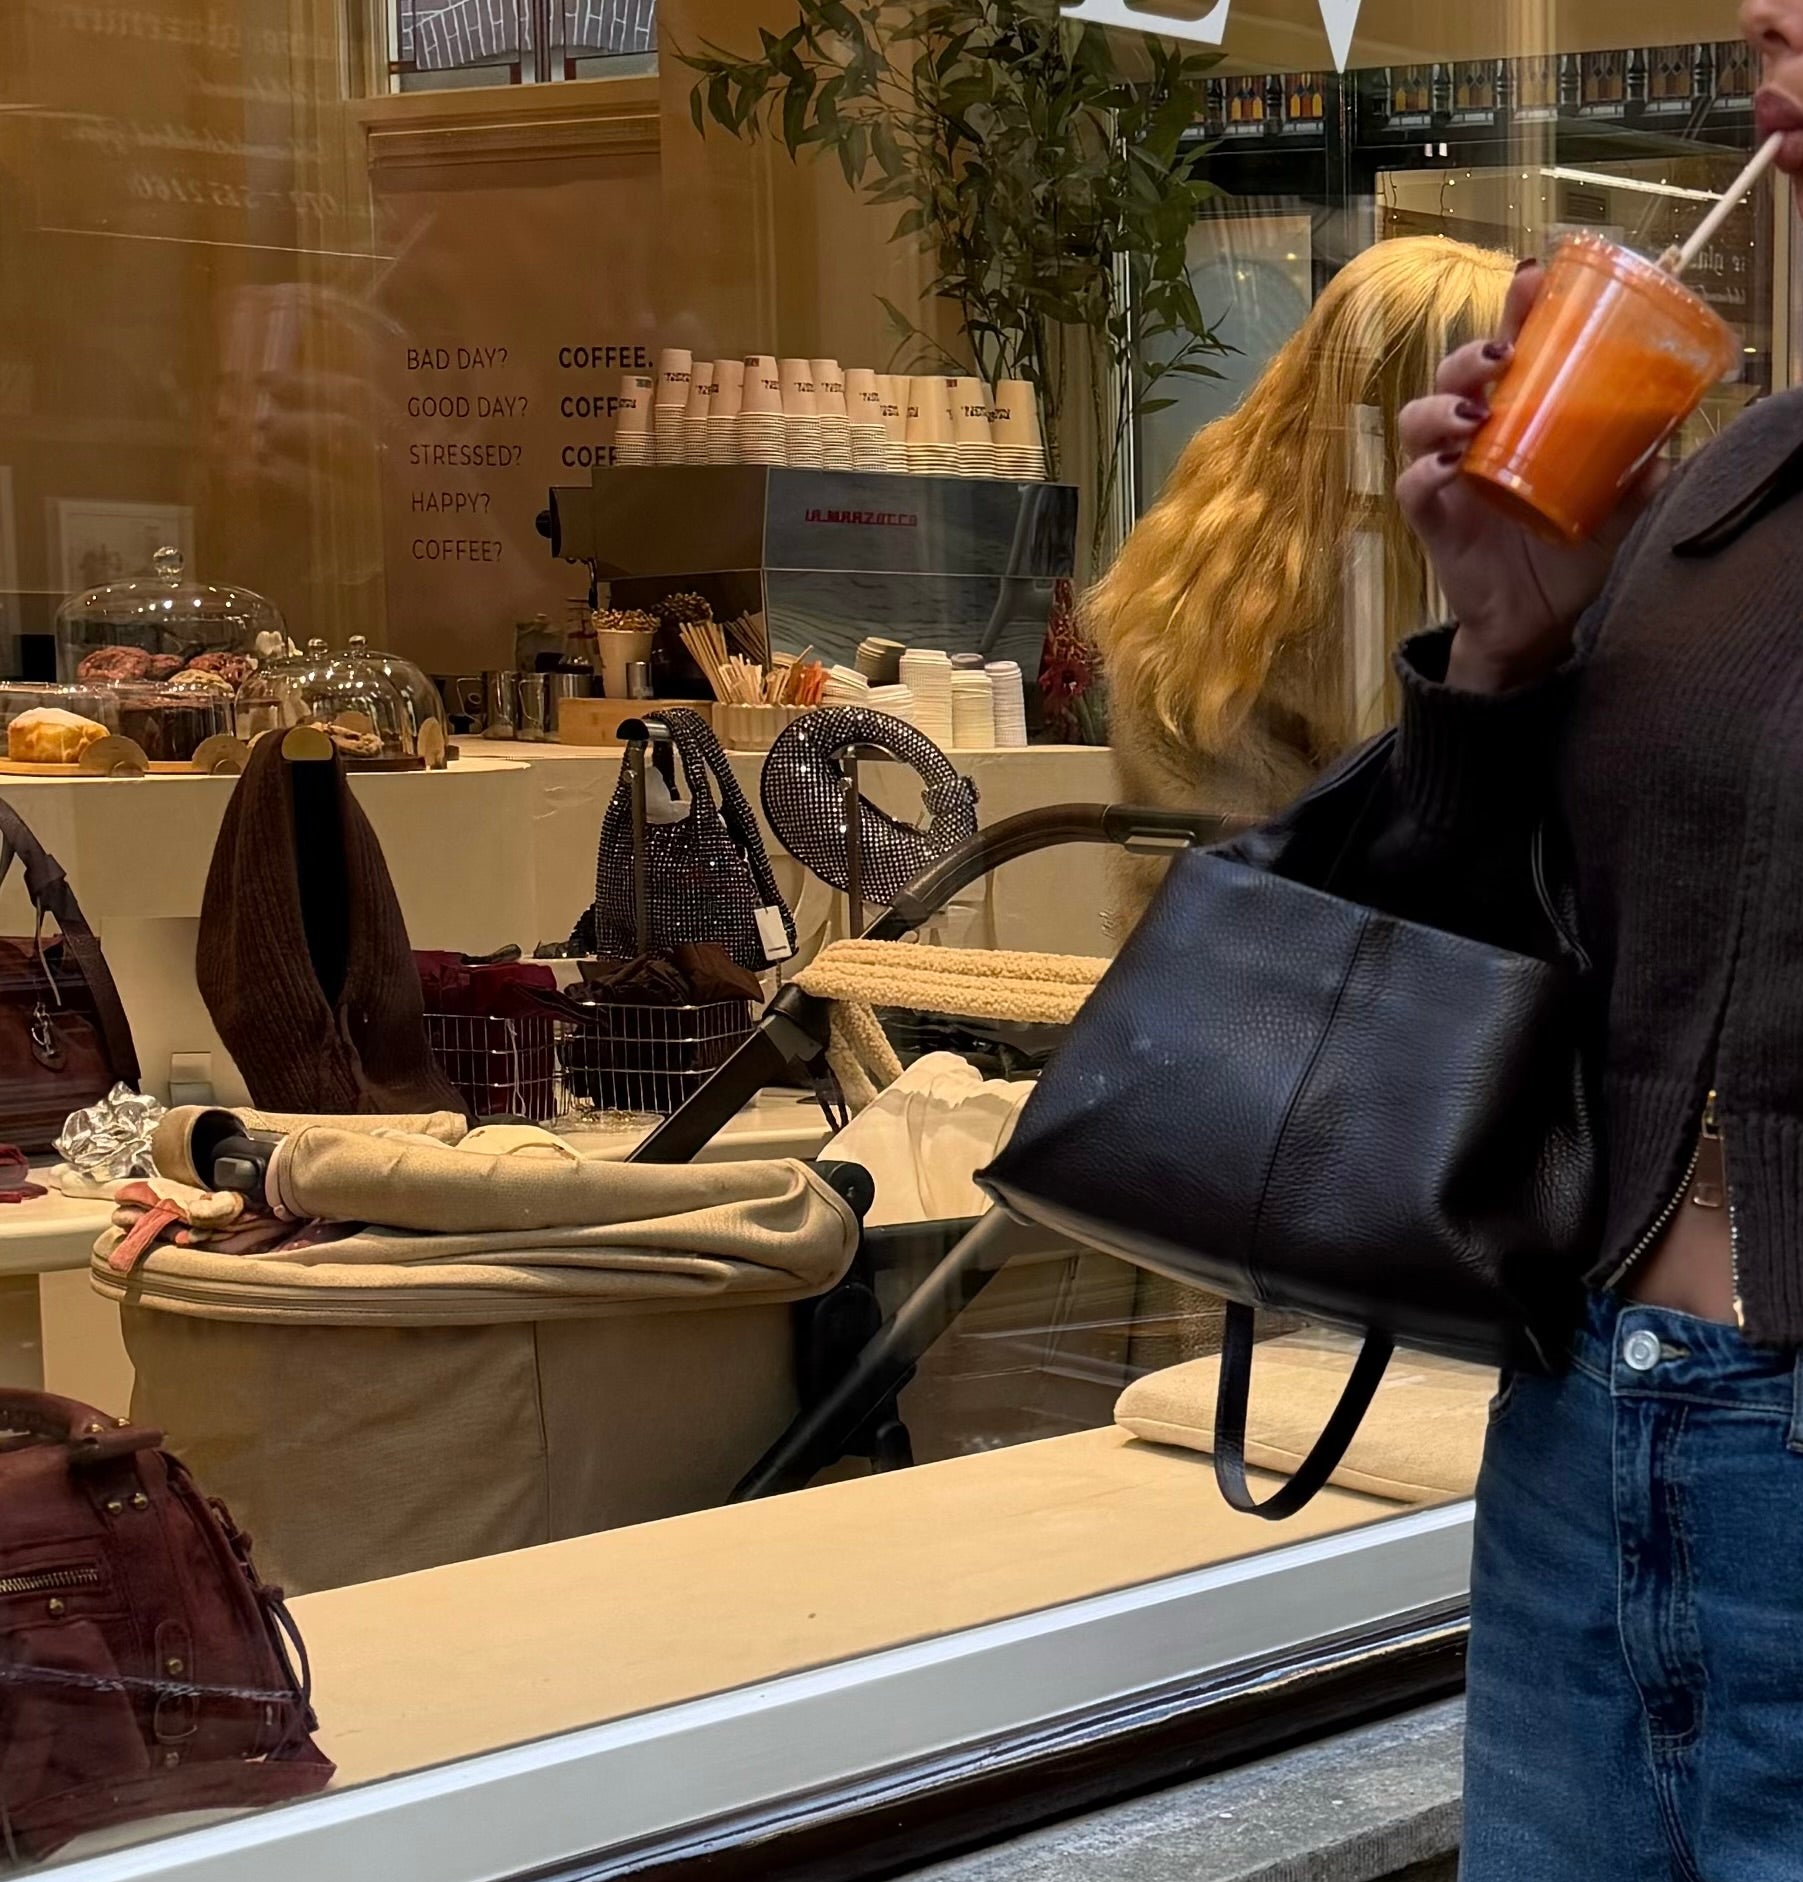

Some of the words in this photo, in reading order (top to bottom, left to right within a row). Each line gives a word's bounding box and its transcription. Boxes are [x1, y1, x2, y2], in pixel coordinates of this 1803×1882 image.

[407, 348, 450, 370] BAD
[457, 347, 508, 369] DAY?
[558, 346, 654, 369] COFFEE.
[407, 396, 470, 418] GOOD
[477, 396, 528, 418] DAY?
[560, 396, 618, 418] COFF
[409, 444, 522, 467] STRESSED?
[561, 445, 617, 467] COFF
[411, 492, 490, 513] HAPPY?
[412, 539, 502, 562] COFFEE?
